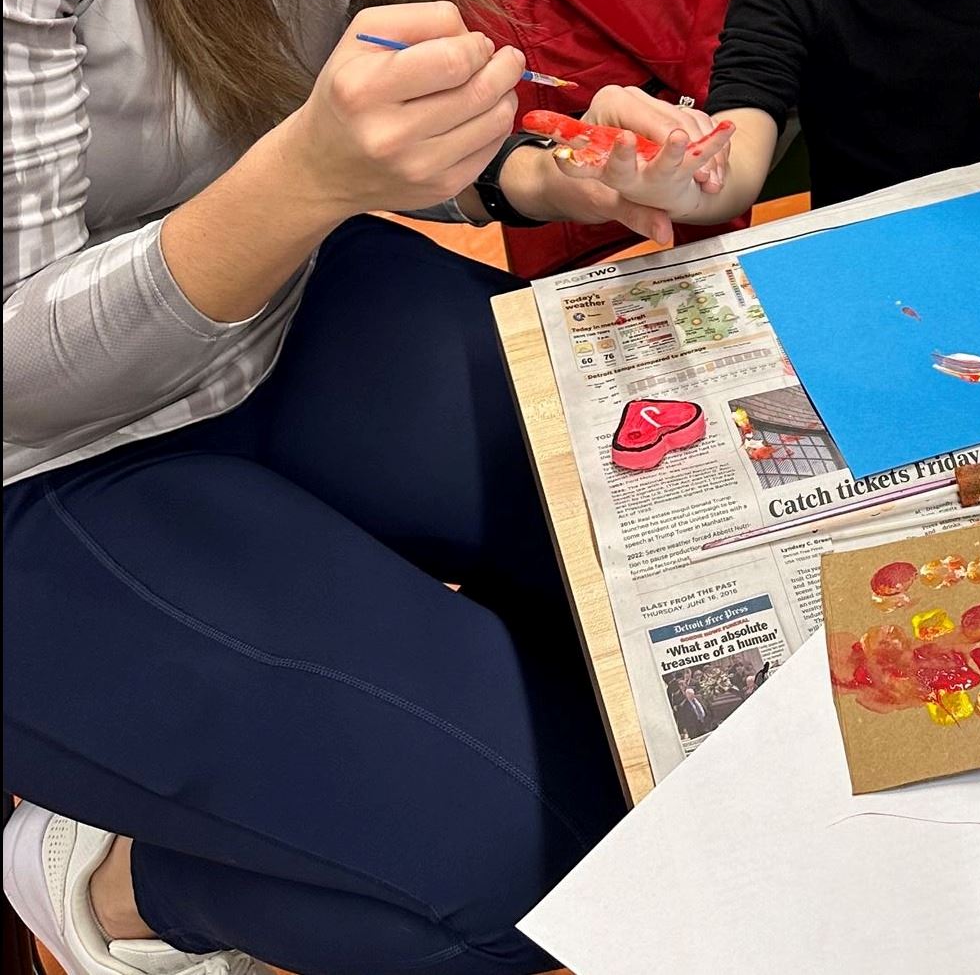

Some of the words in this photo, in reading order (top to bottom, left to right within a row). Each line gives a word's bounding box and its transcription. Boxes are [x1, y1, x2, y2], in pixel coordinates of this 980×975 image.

[563, 293, 600, 304] Today's
[565, 300, 606, 310] weather
[581, 357, 593, 365] 60
[587, 371, 613, 380] Detroit
[613, 365, 636, 373] temps
[637, 356, 670, 368] compared
[680, 347, 707, 357] average
[603, 353, 615, 361] 76
[595, 433, 615, 441] TOD
[768, 487, 832, 518] Catch
[839, 468, 910, 496] tickets
[914, 449, 980, 478] Friday
[671, 506, 690, 514] mogul
[691, 501, 711, 509] Donald
[622, 523, 649, 533] launched
[660, 512, 690, 524] successful
[691, 505, 720, 515] campaign
[623, 533, 640, 541] come
[641, 525, 669, 537] president
[689, 514, 709, 523] United
[710, 510, 729, 518] States
[625, 539, 647, 549] speech
[655, 531, 675, 540] Trump
[675, 526, 694, 534] Tower
[627, 552, 645, 561] 2022:
[645, 546, 666, 555] Severe
[667, 539, 691, 549] weather
[692, 532, 712, 543] forced
[713, 527, 734, 537] Abbott
[781, 543, 806, 553] Lyndsey
[650, 553, 668, 563] pause
[669, 545, 701, 558] production
[630, 566, 654, 575] formula
[655, 560, 677, 569] factory
[640, 601, 668, 613] BLAST
[670, 593, 695, 605] FROM
[696, 585, 714, 597] THE
[715, 580, 737, 591] PAST
[686, 599, 706, 609] JUNE
[707, 594, 718, 602] 16,
[720, 588, 738, 597] 2016
[674, 620, 704, 634] Detroit
[704, 612, 724, 625] Free
[724, 606, 749, 619] Press
[704, 638, 718, 649] an
[721, 621, 768, 643] absolute
[661, 651, 711, 672] treasure
[713, 646, 724, 657] of
[727, 645, 735, 653] a
